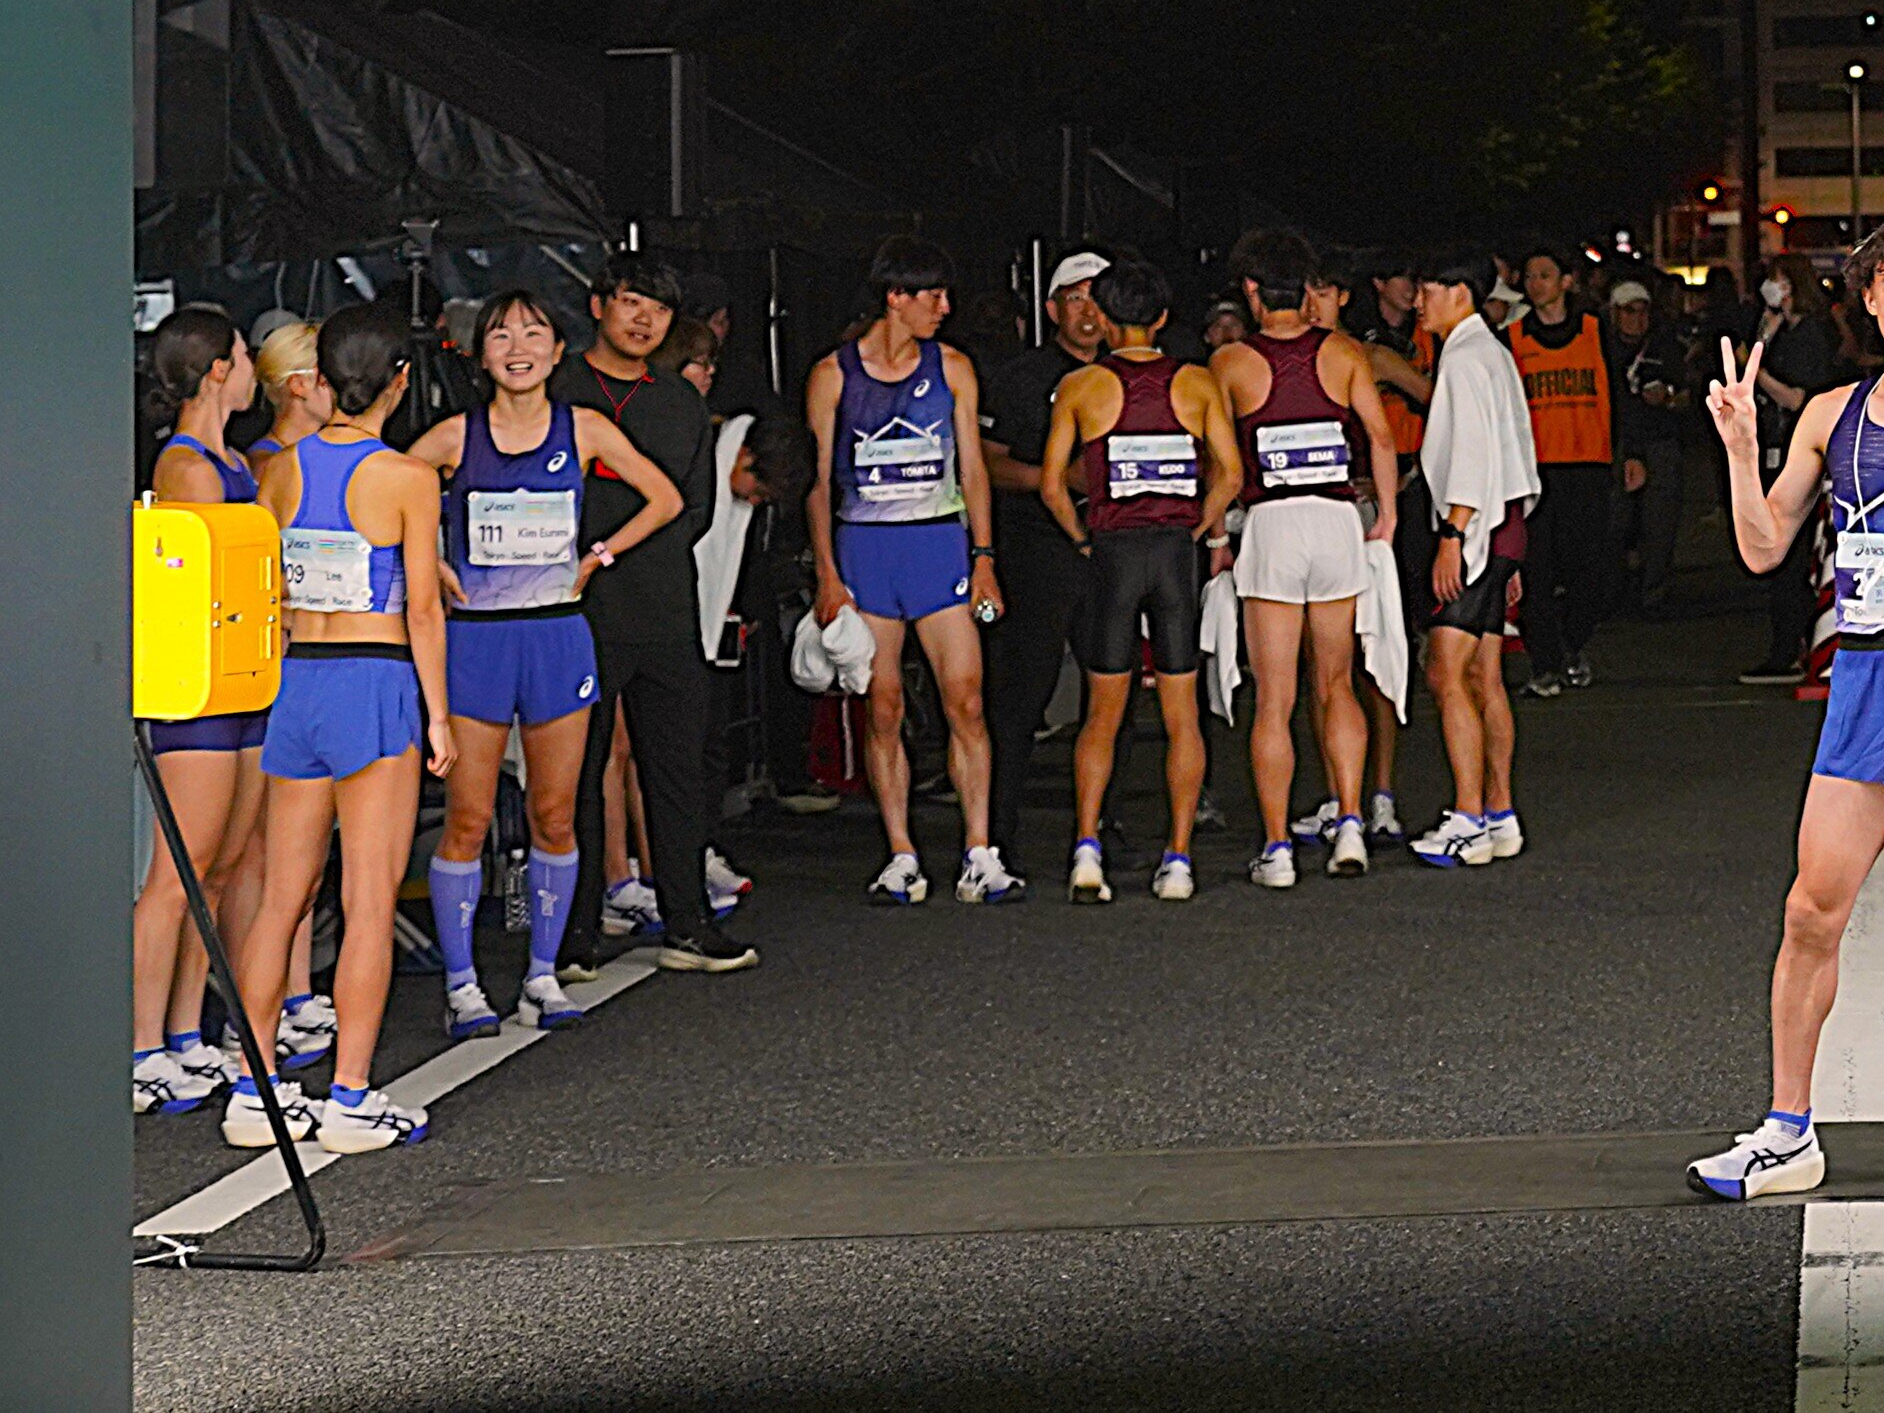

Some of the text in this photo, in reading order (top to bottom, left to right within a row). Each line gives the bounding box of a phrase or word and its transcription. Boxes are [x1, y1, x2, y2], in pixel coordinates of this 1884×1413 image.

[1524, 369, 1598, 400] OFFICIAL
[1267, 452, 1288, 469] 19
[868, 465, 937, 483] 4 TOMITA
[1118, 462, 1138, 479] 15
[478, 524, 503, 543] 111
[518, 528, 537, 538] Kim
[284, 563, 305, 584] 09
